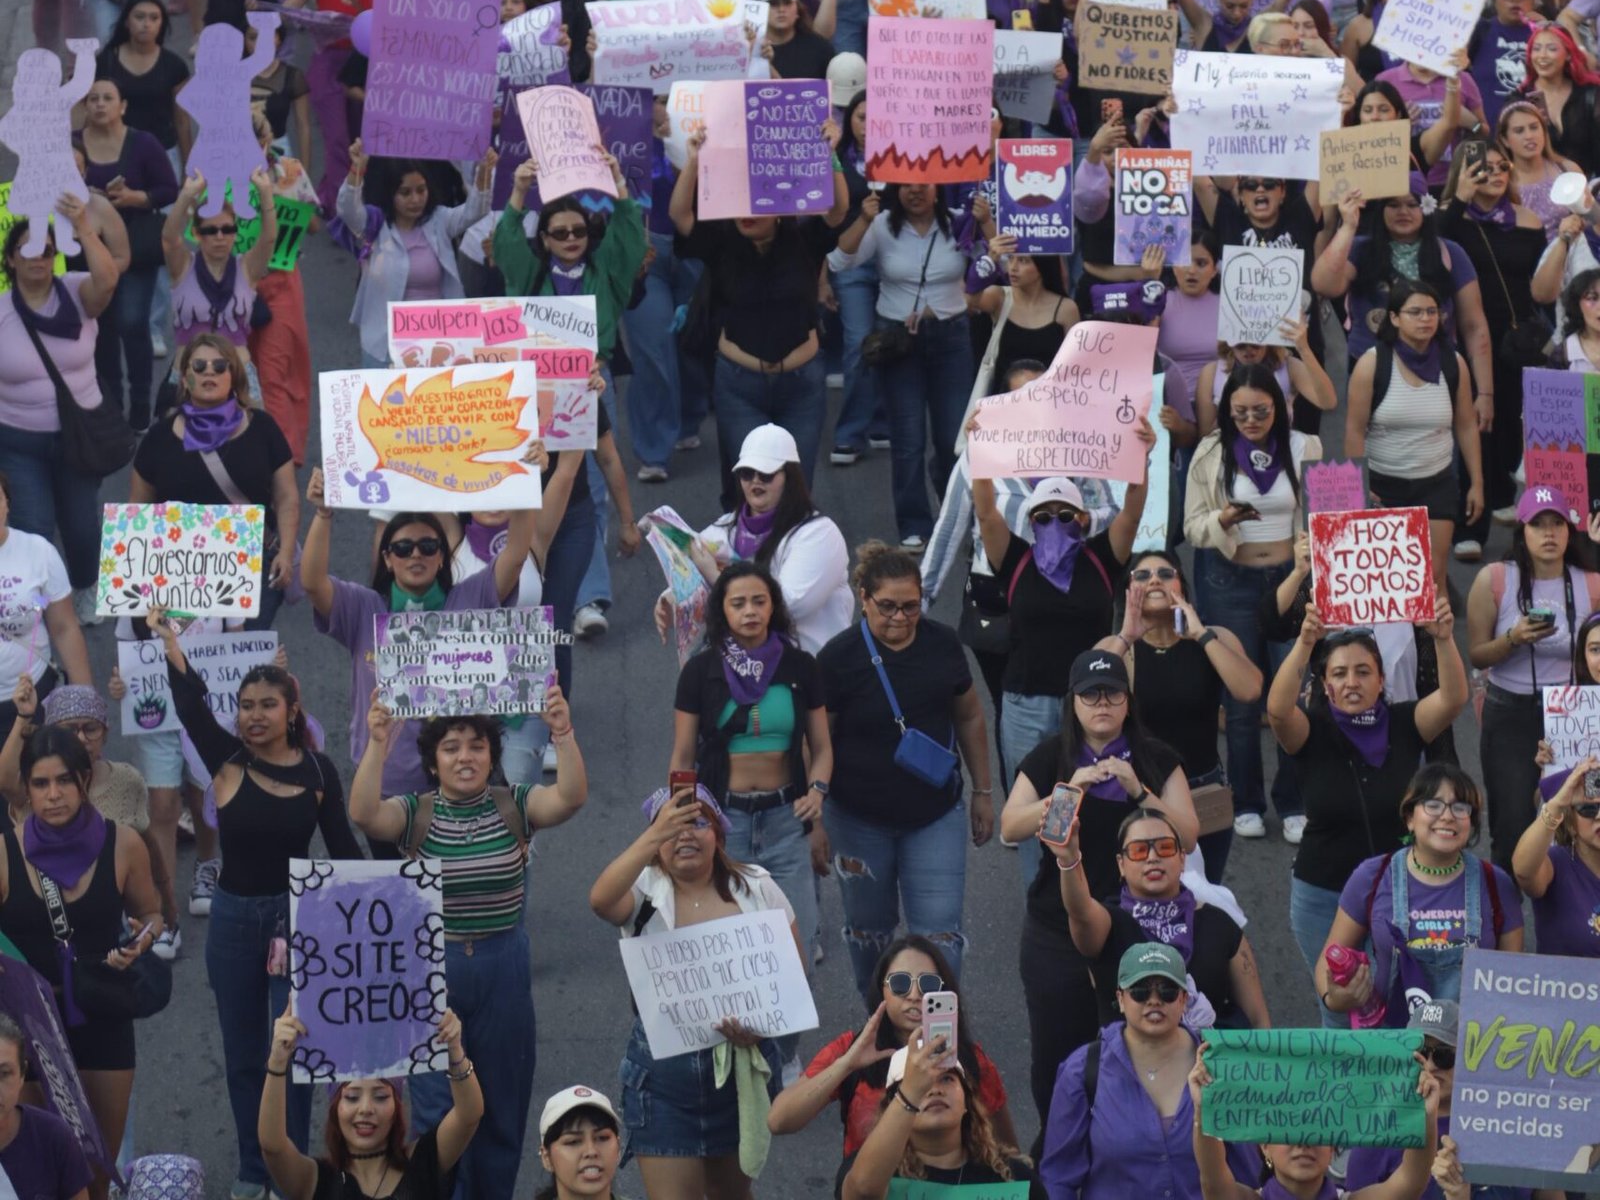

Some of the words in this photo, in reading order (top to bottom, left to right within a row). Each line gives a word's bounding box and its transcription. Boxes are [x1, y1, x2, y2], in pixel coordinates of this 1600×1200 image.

[1086, 4, 1174, 30] QUEREMOS
[1405, 10, 1434, 31] sin
[1437, 7, 1471, 31] vivir
[970, 28, 988, 44] LAS
[1100, 25, 1172, 43] JUSTICIA
[650, 62, 674, 79] NO
[966, 70, 987, 83] TUS
[1088, 63, 1111, 79] NO
[1194, 62, 1222, 88] My
[763, 106, 783, 122] NO
[785, 102, 818, 122] ESTÁS
[934, 103, 982, 117] MADRES
[1232, 104, 1270, 119] FALL
[754, 124, 822, 141] DENUNCIADO
[871, 118, 893, 139] NO
[898, 121, 915, 134] TE
[1252, 120, 1271, 130] the
[611, 141, 647, 158] que
[1011, 145, 1057, 157] LIBRES
[1208, 134, 1289, 155] PATRIARCHY
[766, 163, 785, 176] QUE
[1120, 157, 1129, 168] A
[1131, 157, 1154, 169] LAS
[1155, 156, 1190, 169] NIÑAS
[1326, 159, 1348, 174] que
[1122, 170, 1167, 193] NO
[1169, 169, 1188, 182] SE
[1121, 195, 1189, 216] TOCA
[1008, 213, 1049, 225] VIVAS
[1052, 213, 1062, 225] &
[1003, 226, 1024, 238] SIN
[1027, 225, 1070, 238] MIEDO
[1239, 267, 1292, 288] LIBRES
[392, 308, 479, 335] Disculpen
[484, 314, 520, 340] las
[523, 300, 597, 338] molestias
[414, 391, 465, 405] NUESTRO
[467, 387, 502, 399] GRITO
[423, 405, 437, 415] DE
[440, 404, 454, 413] UN
[1533, 411, 1576, 426] TODAS
[369, 415, 423, 428] CANSADO
[427, 415, 444, 425] DE
[448, 414, 487, 424] VIVIR
[490, 411, 515, 423] CON
[406, 426, 461, 445] MIEDO
[1027, 426, 1107, 447] empoderada
[1112, 433, 1122, 453] y
[1354, 520, 1405, 546] HOY
[1334, 543, 1421, 569] TODAS
[1334, 570, 1420, 598] SOMOS
[1354, 596, 1405, 622] UNA
[231, 640, 274, 655] NACIDO
[397, 653, 427, 667] por
[432, 649, 493, 670] mujeres
[514, 653, 548, 668] que
[216, 667, 241, 681] SEA
[378, 677, 397, 689] se
[409, 671, 496, 686] atrevieron
[506, 672, 516, 682] a
[459, 695, 474, 709] el
[54, 914, 67, 934] LA
[335, 899, 393, 937] YO
[1415, 920, 1452, 931] GIRLS
[702, 932, 733, 957] POR
[735, 926, 755, 949] MI
[758, 922, 775, 945] YO
[1473, 968, 1600, 1002] Nacimos
[1211, 1058, 1292, 1082] TIENEN
[1461, 1088, 1490, 1103] no
[1497, 1090, 1550, 1109] para
[1558, 1095, 1592, 1112] ser
[1356, 1109, 1400, 1135] UNA
[1459, 1115, 1563, 1138] vencidas
